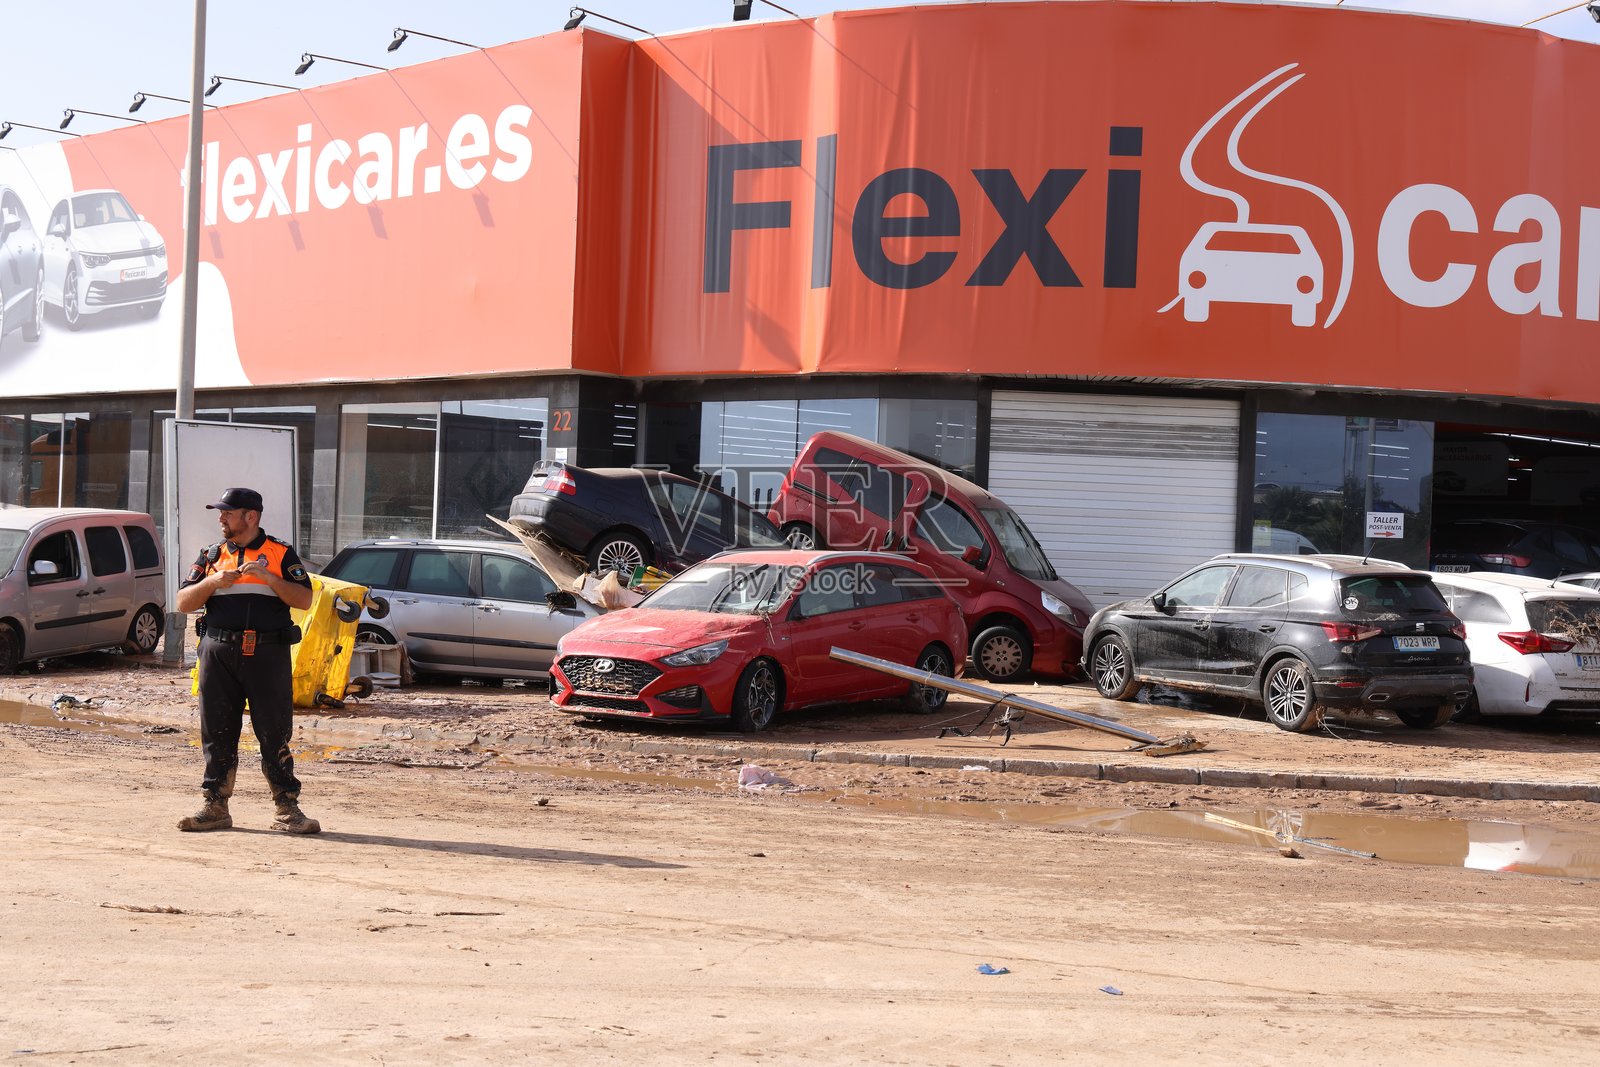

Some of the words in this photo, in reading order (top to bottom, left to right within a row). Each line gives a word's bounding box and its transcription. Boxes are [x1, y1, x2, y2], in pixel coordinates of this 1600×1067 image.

[703, 125, 1143, 294] Flexi
[552, 410, 572, 431] 22
[1373, 516, 1399, 524] TALLER
[1399, 637, 1420, 647] 7023
[1421, 637, 1437, 647] MRP
[1582, 655, 1600, 666] 811
